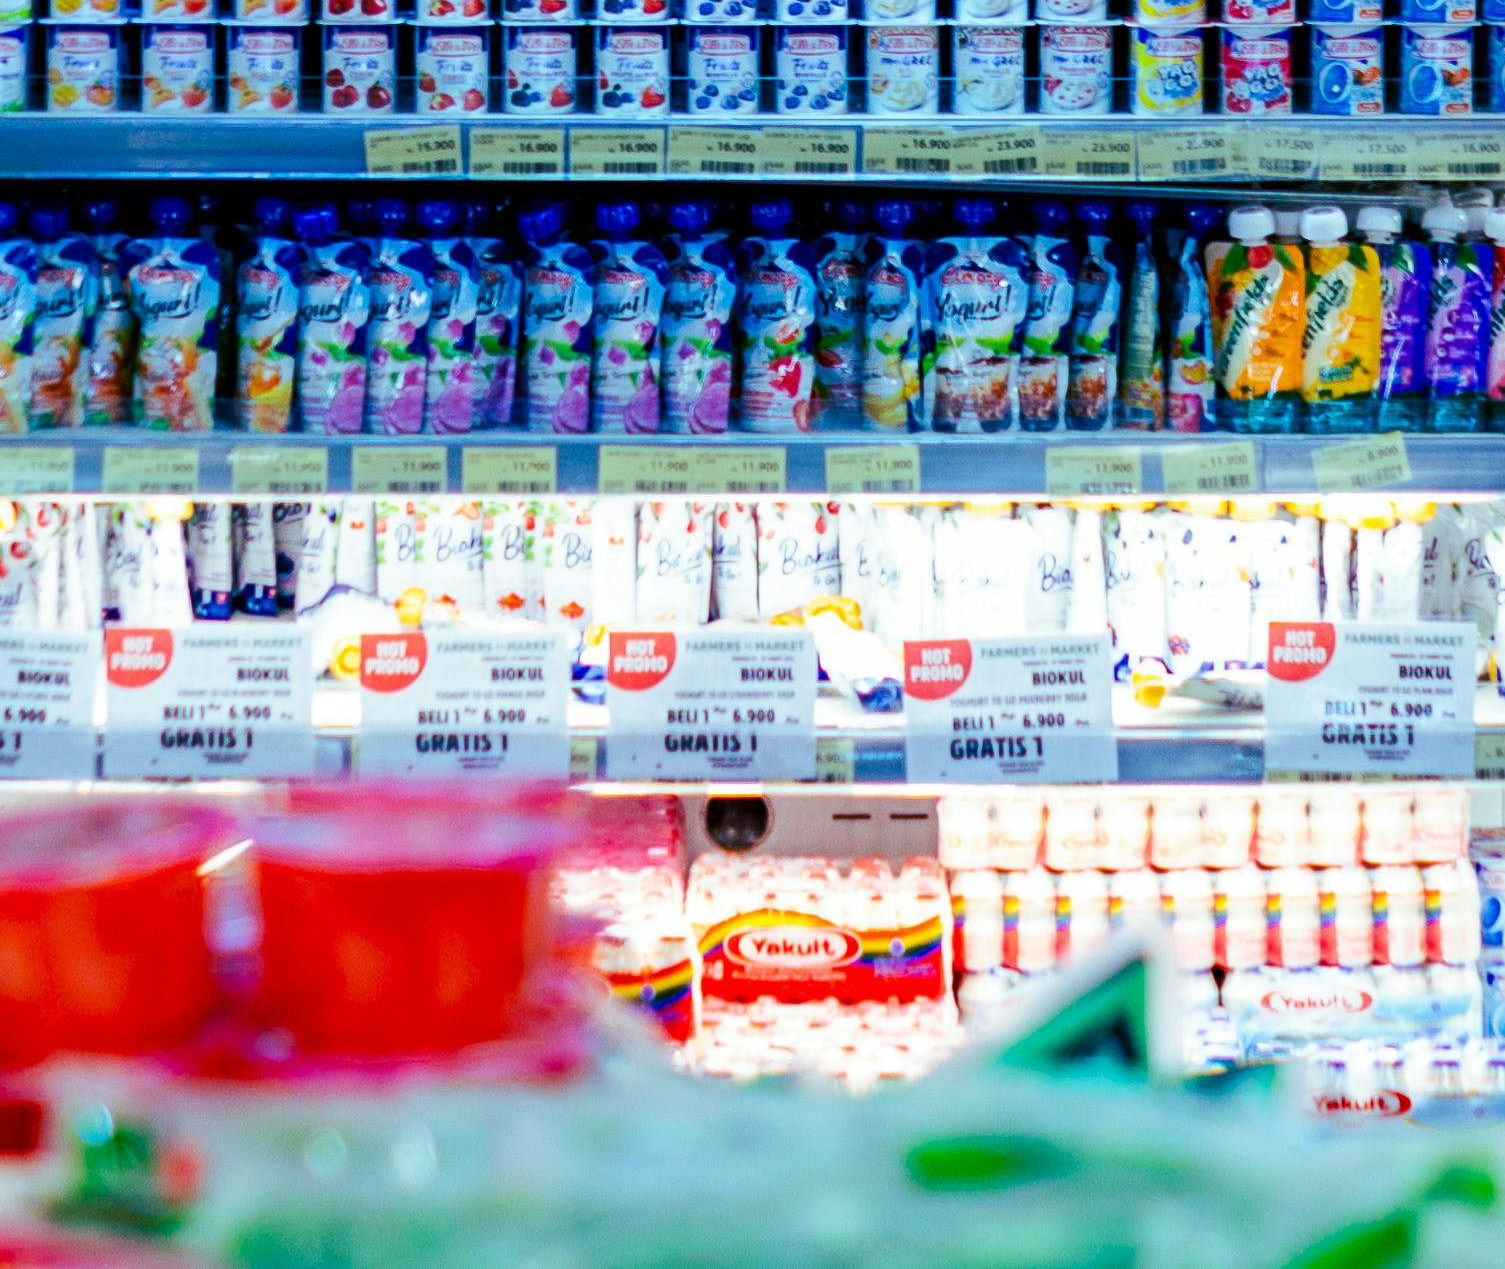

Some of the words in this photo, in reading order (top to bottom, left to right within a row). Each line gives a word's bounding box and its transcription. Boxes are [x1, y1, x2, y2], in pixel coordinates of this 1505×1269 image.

[519, 143, 557, 153] 16.900
[619, 143, 657, 153] 16.900
[718, 142, 756, 153] 16.900
[811, 144, 848, 154] 16.900
[913, 138, 951, 150] 16.900
[436, 642, 492, 653] FARMERS
[507, 640, 556, 651] MARKET
[685, 642, 741, 651] FARMERS
[756, 641, 805, 651] MARKET
[1285, 630, 1315, 647] HOT
[1345, 635, 1400, 645] FARMERS
[1415, 636, 1464, 647] MARKET
[376, 641, 407, 657] HOT
[625, 640, 656, 656] HOT
[980, 645, 1036, 658] FARMERS
[1051, 643, 1100, 654] MARKET
[1273, 646, 1327, 664] PROMO
[614, 656, 668, 673] PROMO
[921, 649, 951, 665] HOT
[365, 657, 421, 675] PROMO
[911, 665, 964, 682] PROMO
[1398, 665, 1452, 680] BIOKUL
[18, 671, 69, 685] BIOKUL
[236, 668, 289, 681] BIOKUL
[491, 668, 544, 682] BIOKUL
[741, 668, 794, 682] BIOKUL
[1032, 670, 1085, 686] BIOKUL
[4, 708, 46, 724] 6.900
[163, 706, 193, 720] BELI
[229, 706, 271, 720] 6.900
[418, 710, 449, 724] BELI
[484, 709, 526, 724] 6.900
[667, 710, 698, 724] BELI
[733, 709, 775, 724] 6.900
[1325, 701, 1355, 715] BELI
[1390, 703, 1432, 717] 6.900
[953, 716, 984, 731] BELI
[1023, 713, 1065, 728] 6.900
[13, 732, 22, 750] 1
[161, 728, 236, 749] GRATIS
[245, 728, 252, 748] 1
[1322, 724, 1398, 745] GRATIS
[1405, 725, 1414, 745] 1
[416, 734, 491, 753] GRATIS
[500, 734, 508, 752] 1
[665, 734, 741, 752] GRATIS
[750, 734, 757, 752] 1
[950, 737, 1026, 760] GRATIS
[1033, 737, 1043, 756] 1
[751, 938, 836, 956] Yakult
